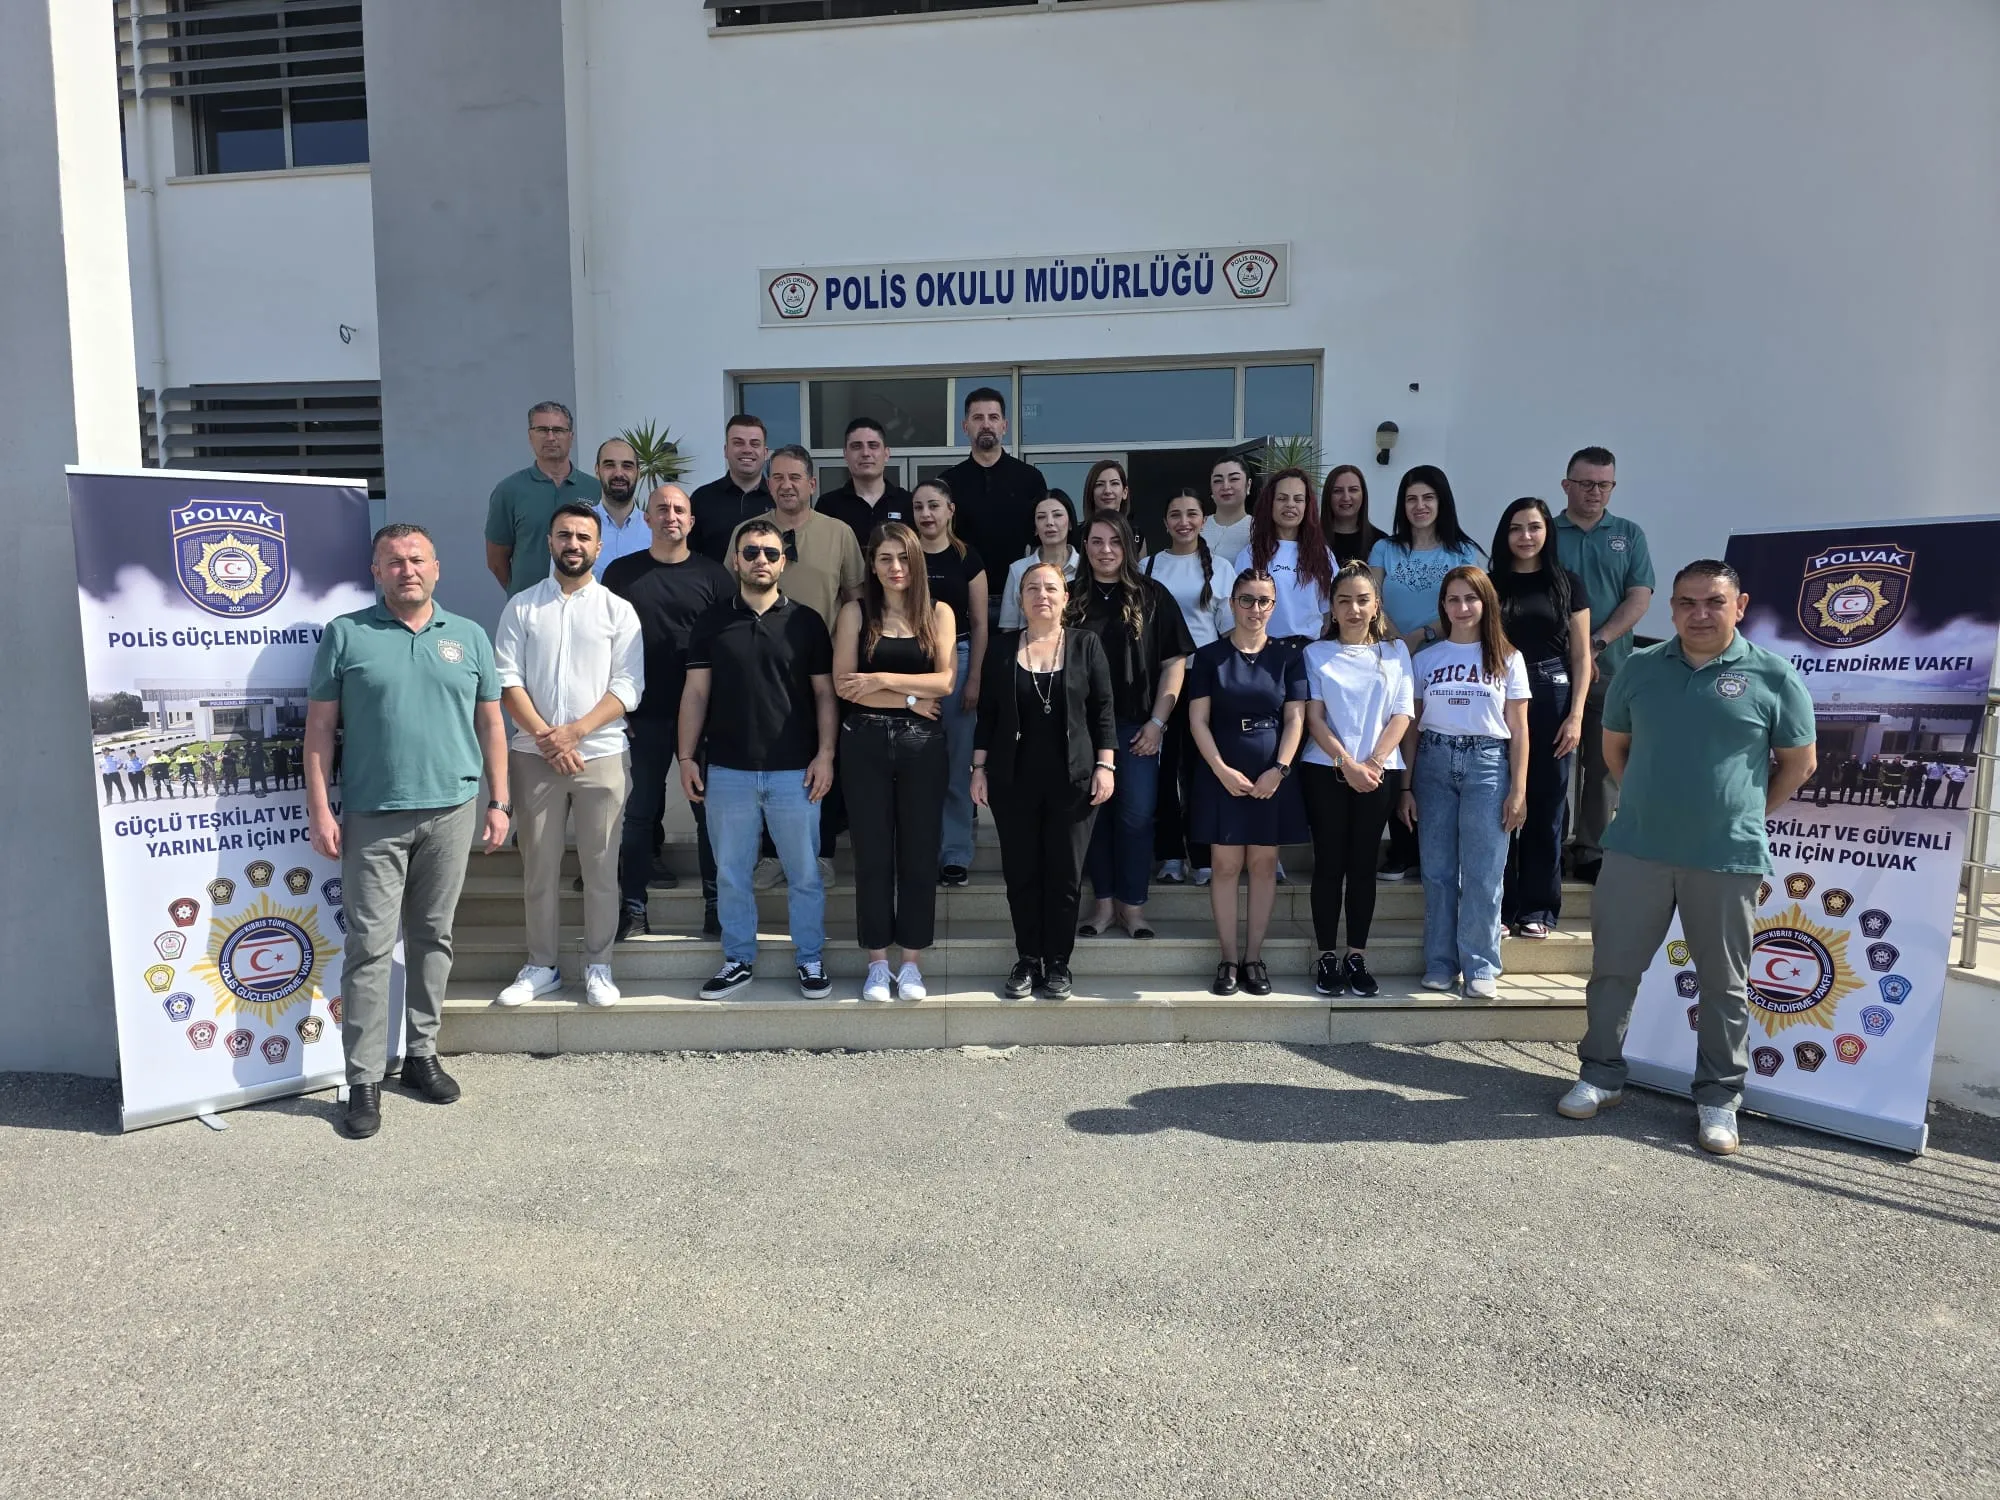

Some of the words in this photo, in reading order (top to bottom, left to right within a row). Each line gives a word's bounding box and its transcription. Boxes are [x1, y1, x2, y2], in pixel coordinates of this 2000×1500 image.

[1231, 256, 1248, 267] POLİS
[1249, 255, 1271, 265] OKULU
[826, 269, 906, 310] POLİS
[916, 270, 1014, 308] OKULU
[1025, 252, 1214, 302] MÜDÜRLÜĞÜ
[181, 508, 275, 528] POLVAK
[1815, 551, 1906, 569] POLVAK
[109, 628, 168, 648] POLİS
[172, 626, 308, 650] GÜÇLENDİRME
[1791, 654, 1910, 676] ÜÇLENDİRME
[1914, 656, 1974, 671] VAKFI
[115, 813, 182, 839] GÜÇLÜ
[187, 807, 273, 833] TEŞKİLAT
[278, 805, 302, 821] VE
[1765, 818, 1831, 839] ŞKİLAT
[1835, 825, 1860, 843] VE
[1863, 826, 1952, 851] GÜVENLİ
[146, 834, 243, 859] YARINLAR
[247, 828, 286, 851] İÇİN
[1795, 841, 1835, 865] İÇİN
[1839, 849, 1918, 872] POLVAK
[244, 919, 267, 933] KIBRIS
[268, 919, 287, 929] TÜRK
[1768, 930, 1793, 938] KIBRIS
[1794, 932, 1813, 945] TÜRK
[298, 949, 313, 977] VAKFI
[1812, 973, 1832, 999] VAKFI
